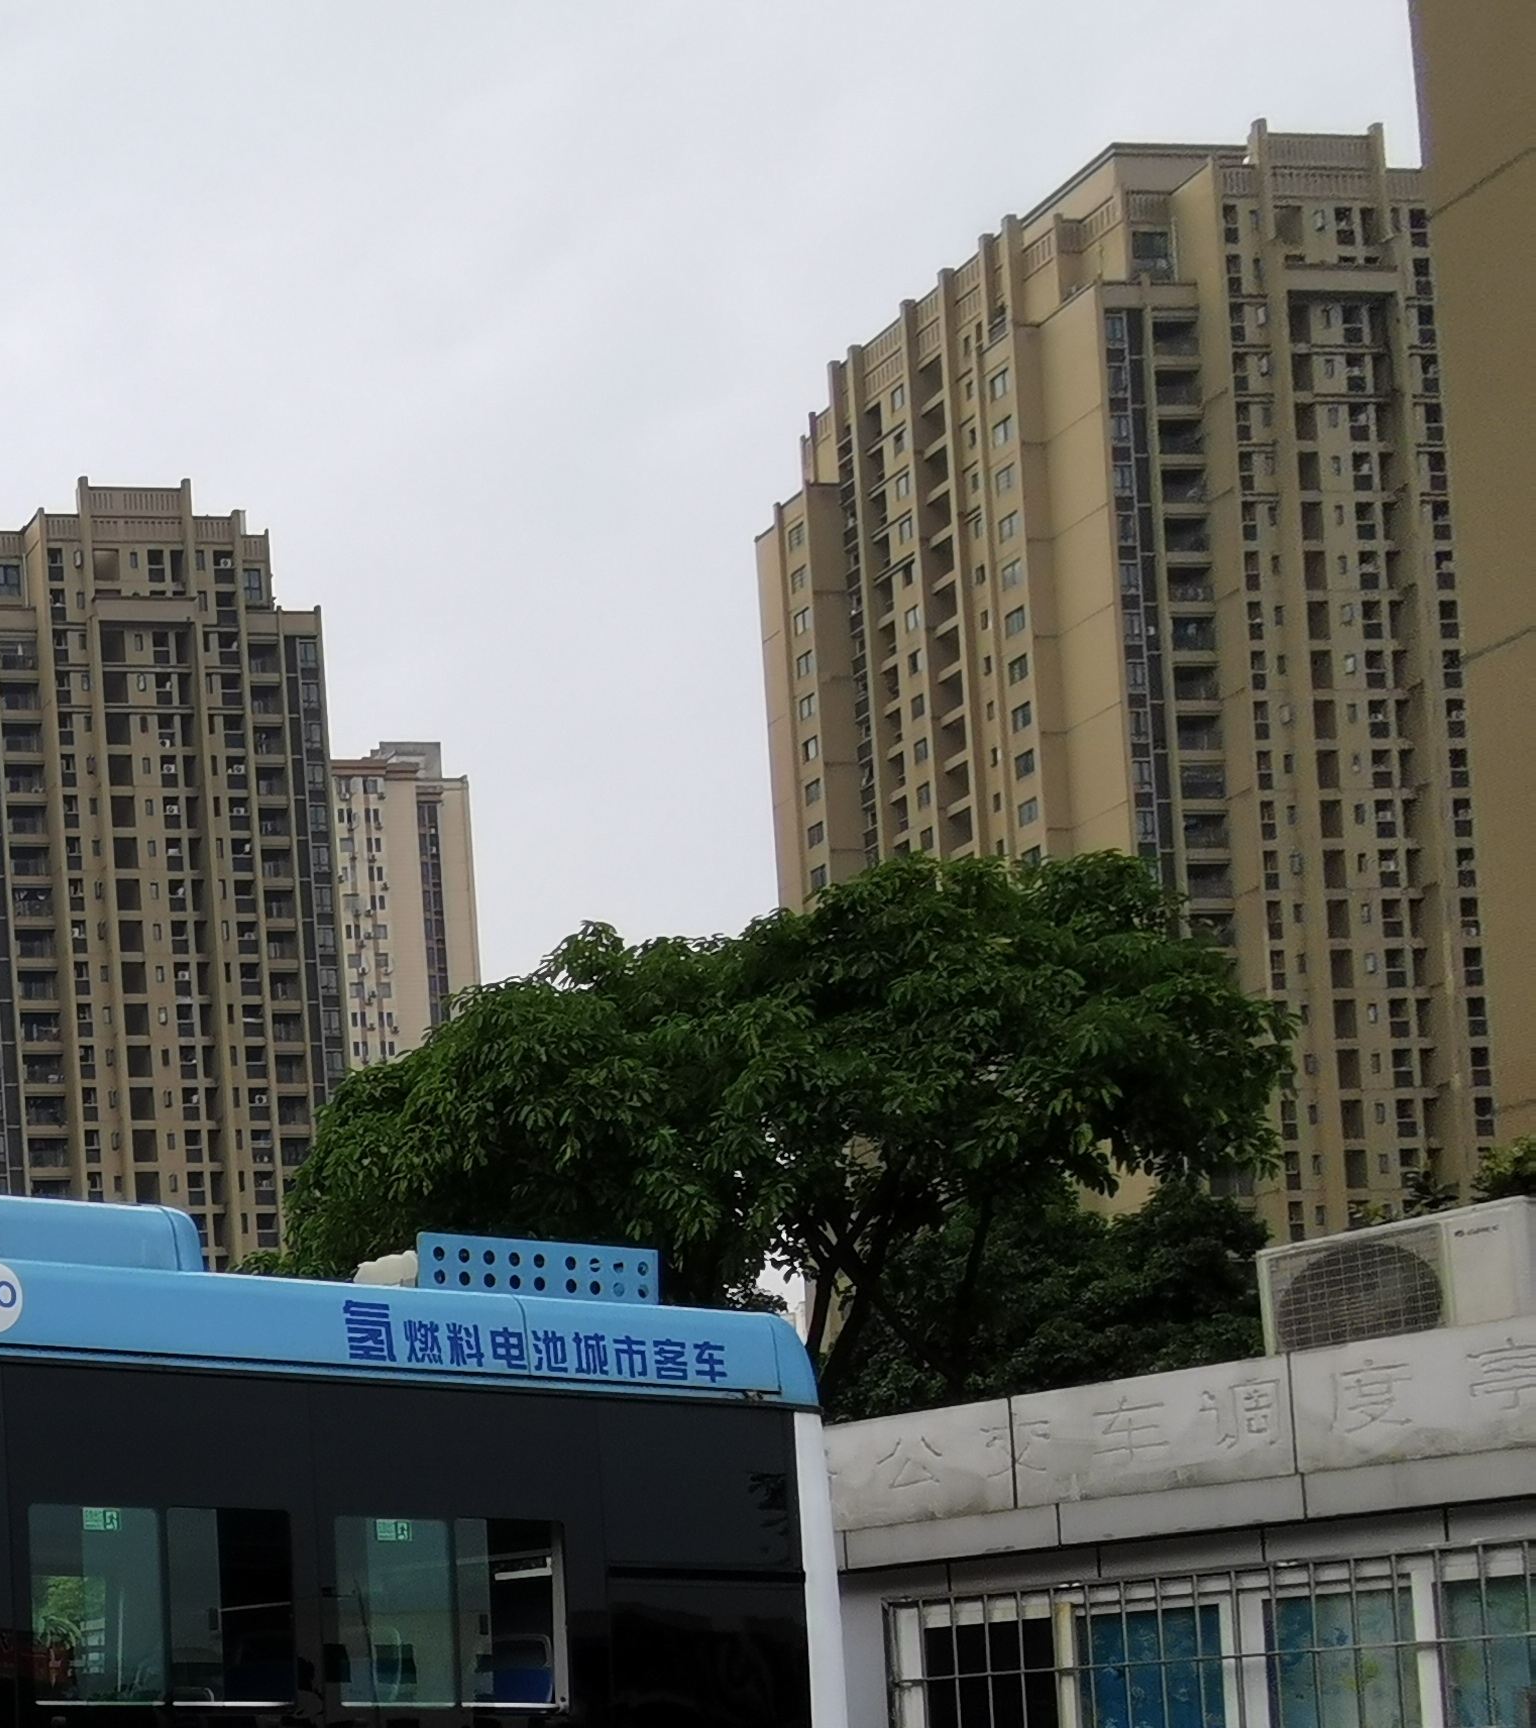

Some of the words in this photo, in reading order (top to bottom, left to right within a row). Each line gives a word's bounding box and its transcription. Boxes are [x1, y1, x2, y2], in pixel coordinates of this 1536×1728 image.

[343, 1299, 727, 1383] 氢燃料电池城市客车
[829, 1337, 1536, 1490] 公交车调度亭
